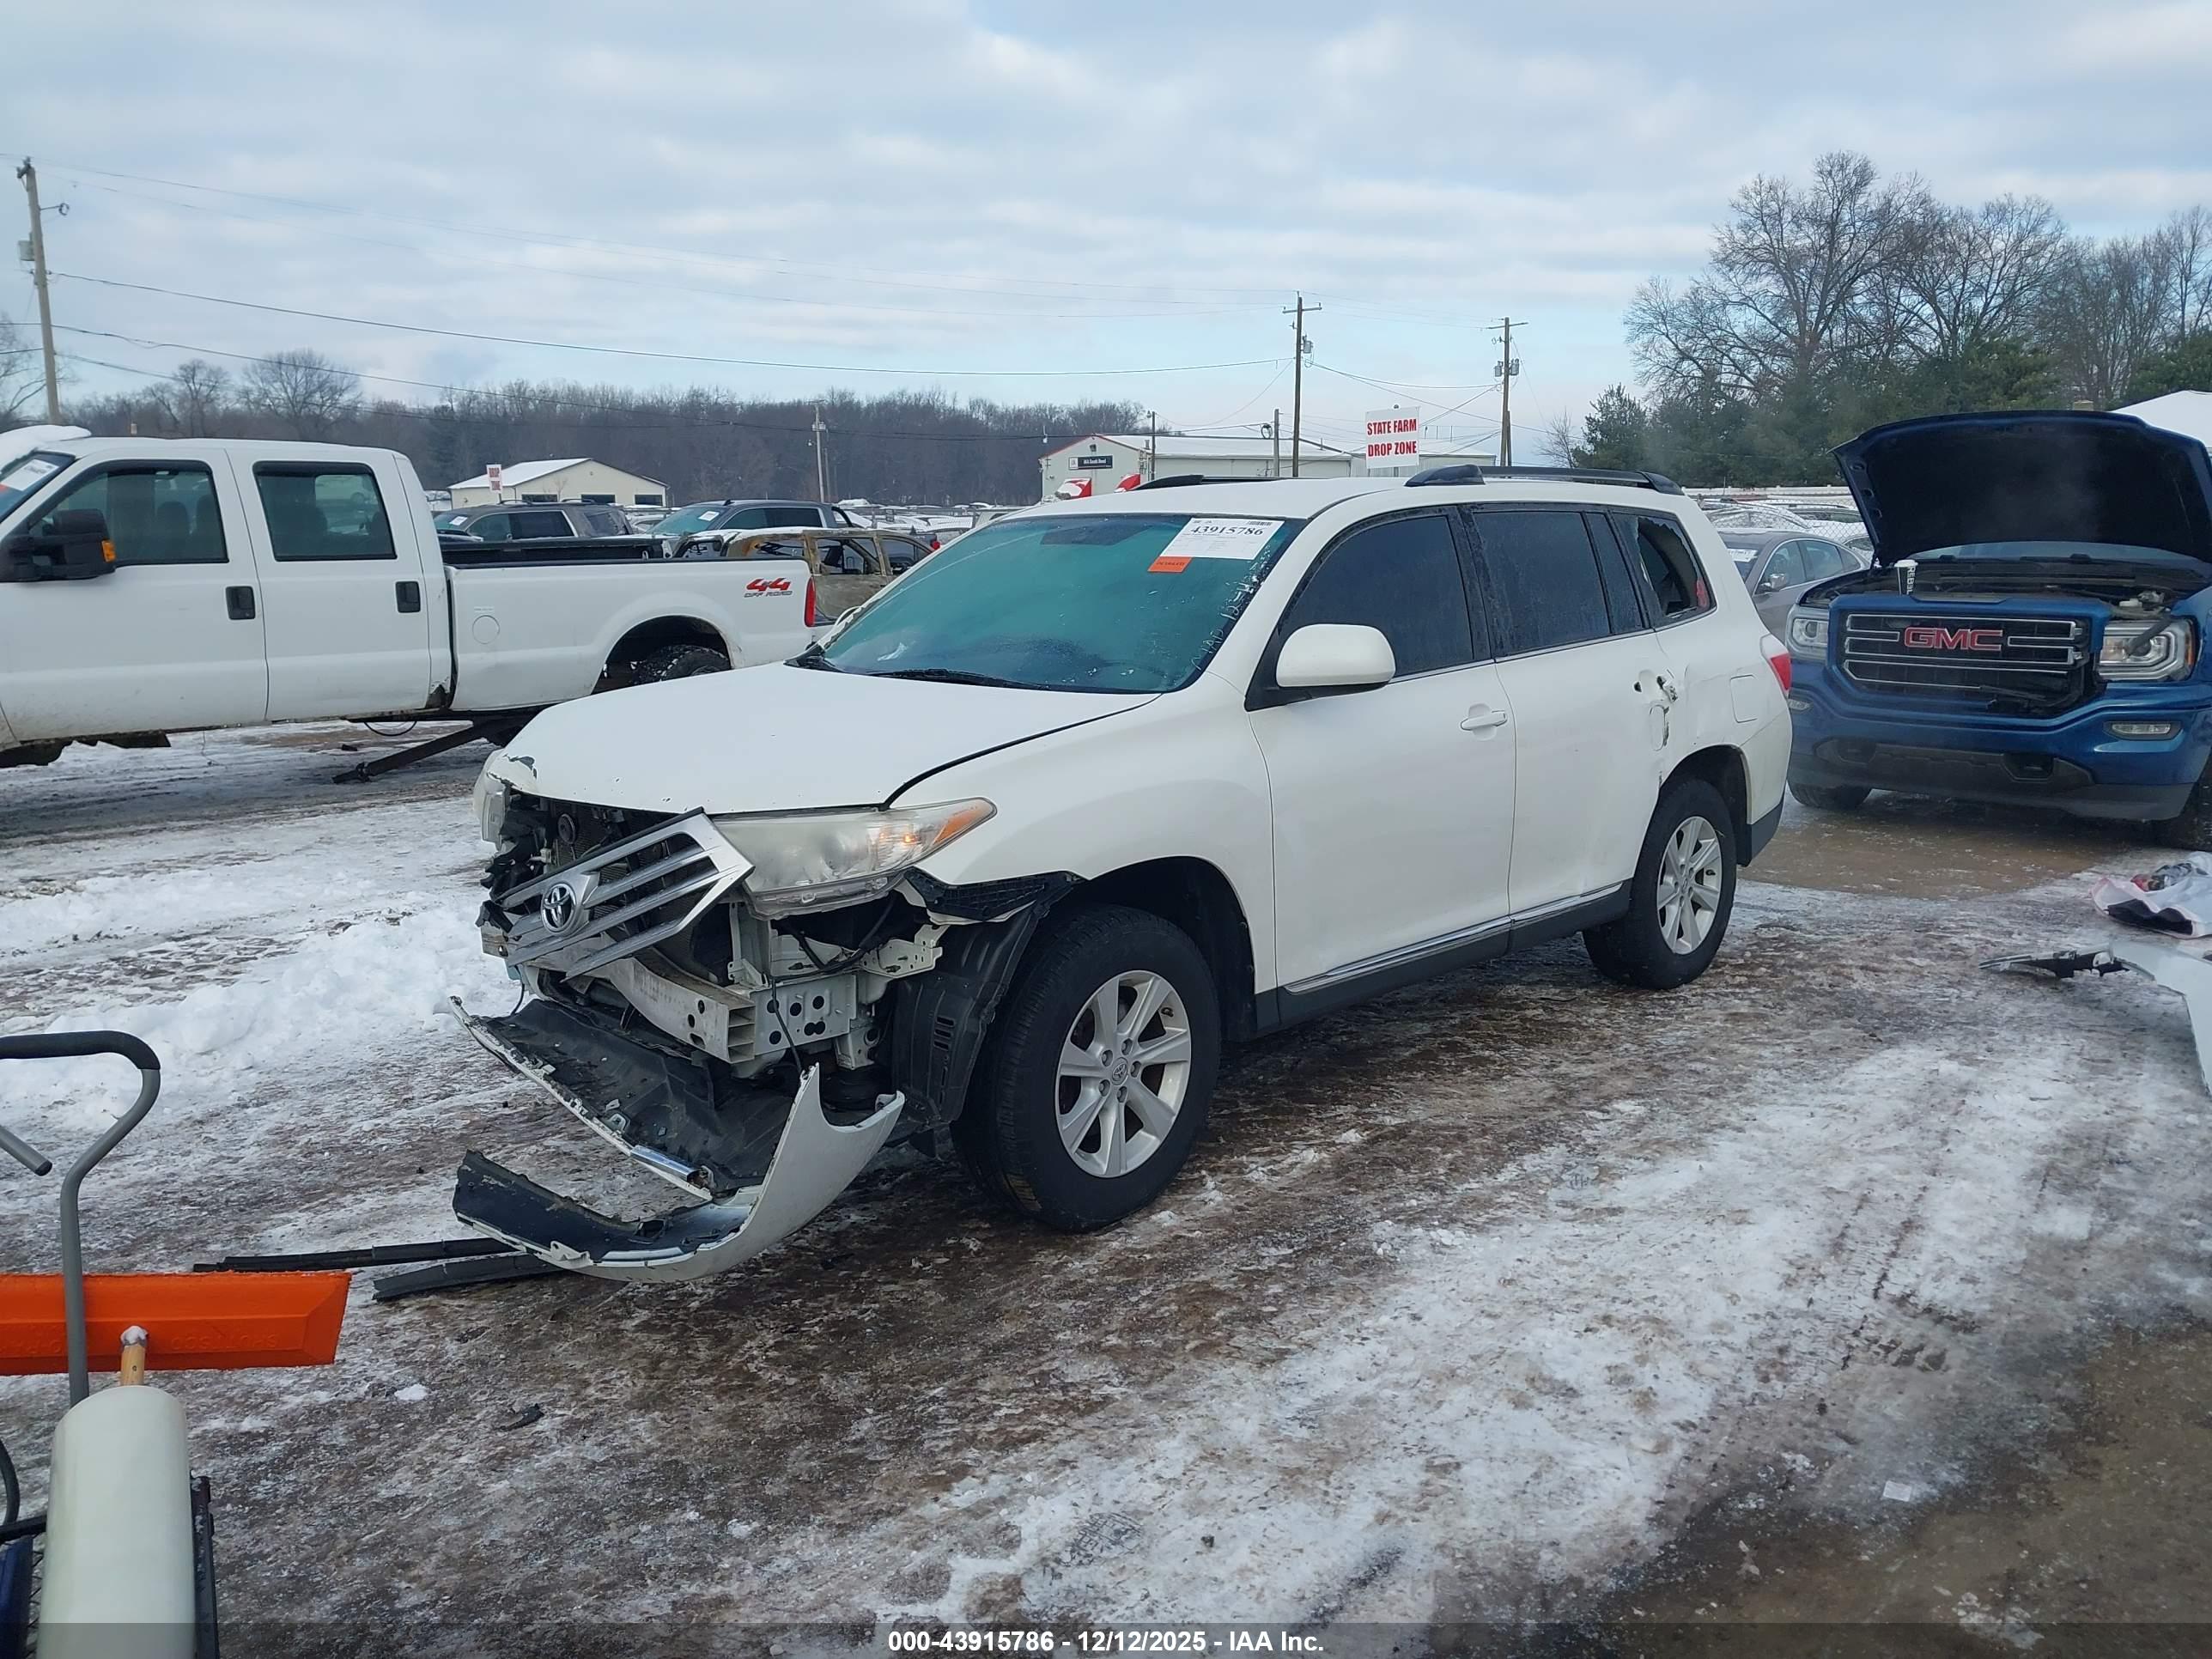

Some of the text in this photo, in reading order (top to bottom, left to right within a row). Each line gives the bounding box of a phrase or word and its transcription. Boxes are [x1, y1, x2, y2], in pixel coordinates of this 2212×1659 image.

[1367, 419, 1417, 435] STATE FARM
[1368, 441, 1417, 457] DROP ZONE
[1190, 526, 1266, 536] 43915786
[1904, 627, 2003, 651] GMC
